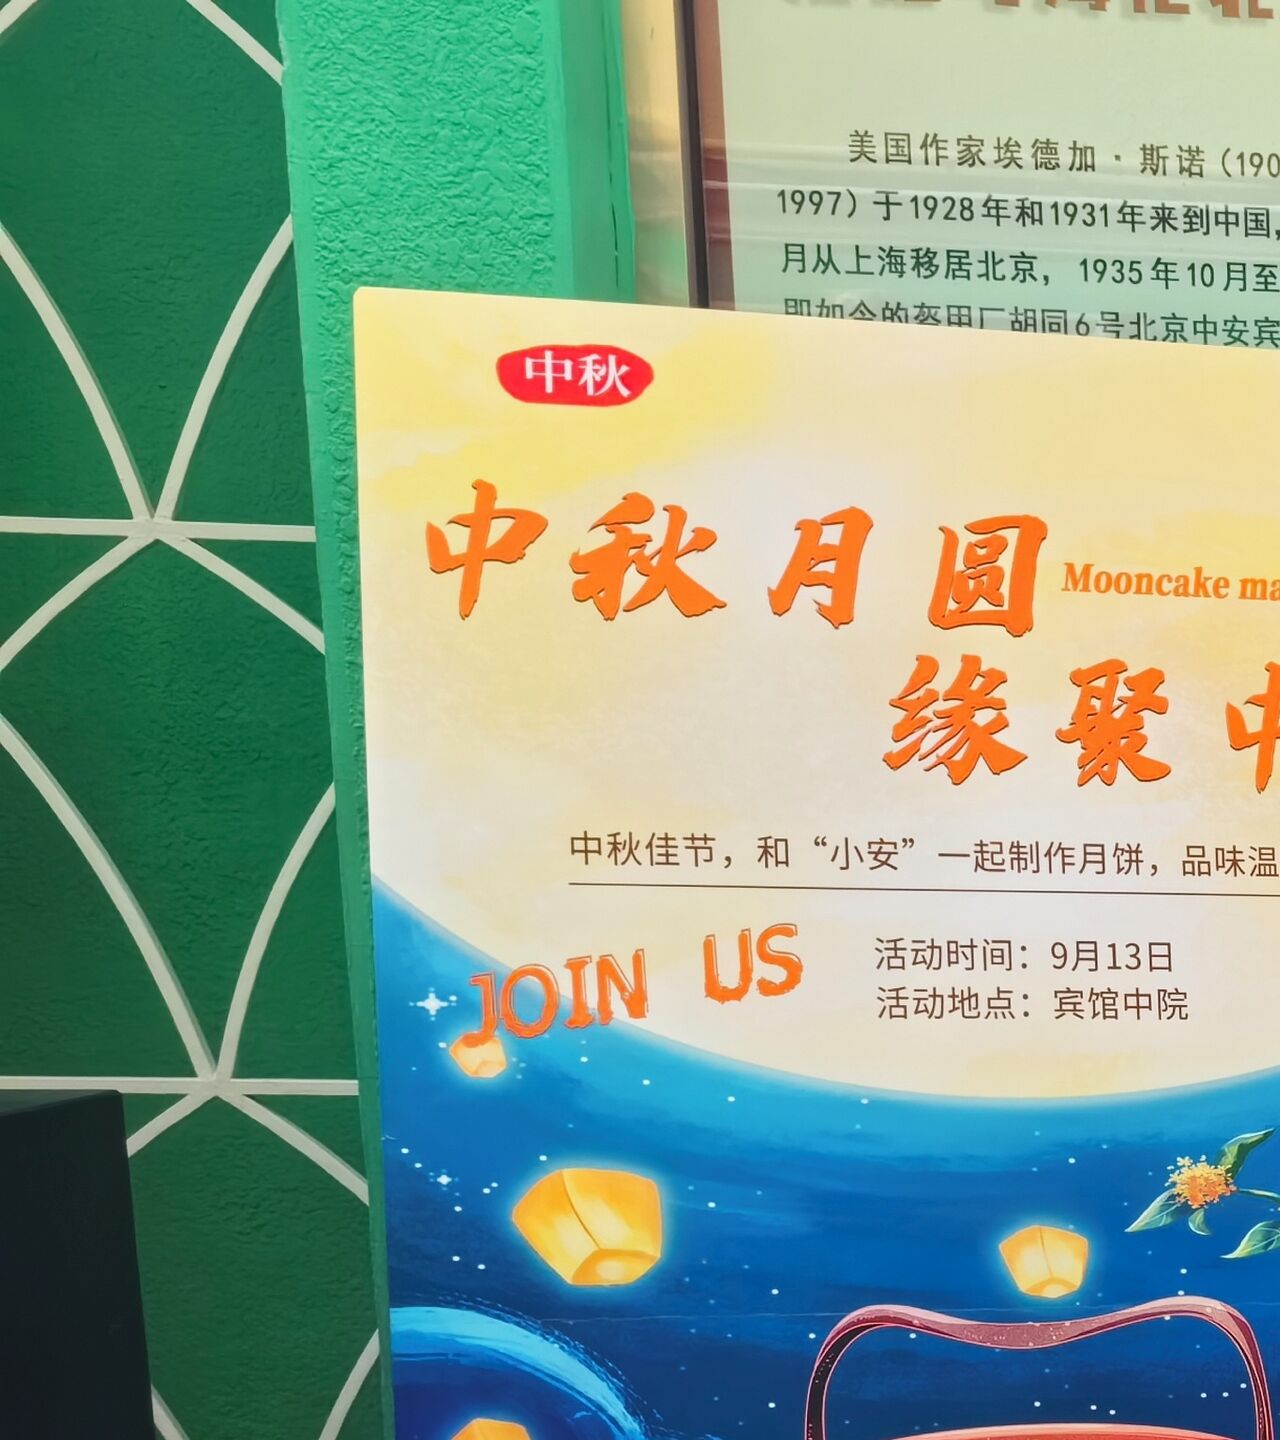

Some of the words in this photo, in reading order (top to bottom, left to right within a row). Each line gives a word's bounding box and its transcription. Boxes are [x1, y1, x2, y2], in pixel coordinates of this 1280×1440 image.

[523, 349, 632, 399] 中秋
[425, 477, 1050, 638] 中秋月圆
[1060, 561, 1230, 601] Mooncake
[463, 947, 650, 1047] JOIN
[702, 922, 804, 1005] US
